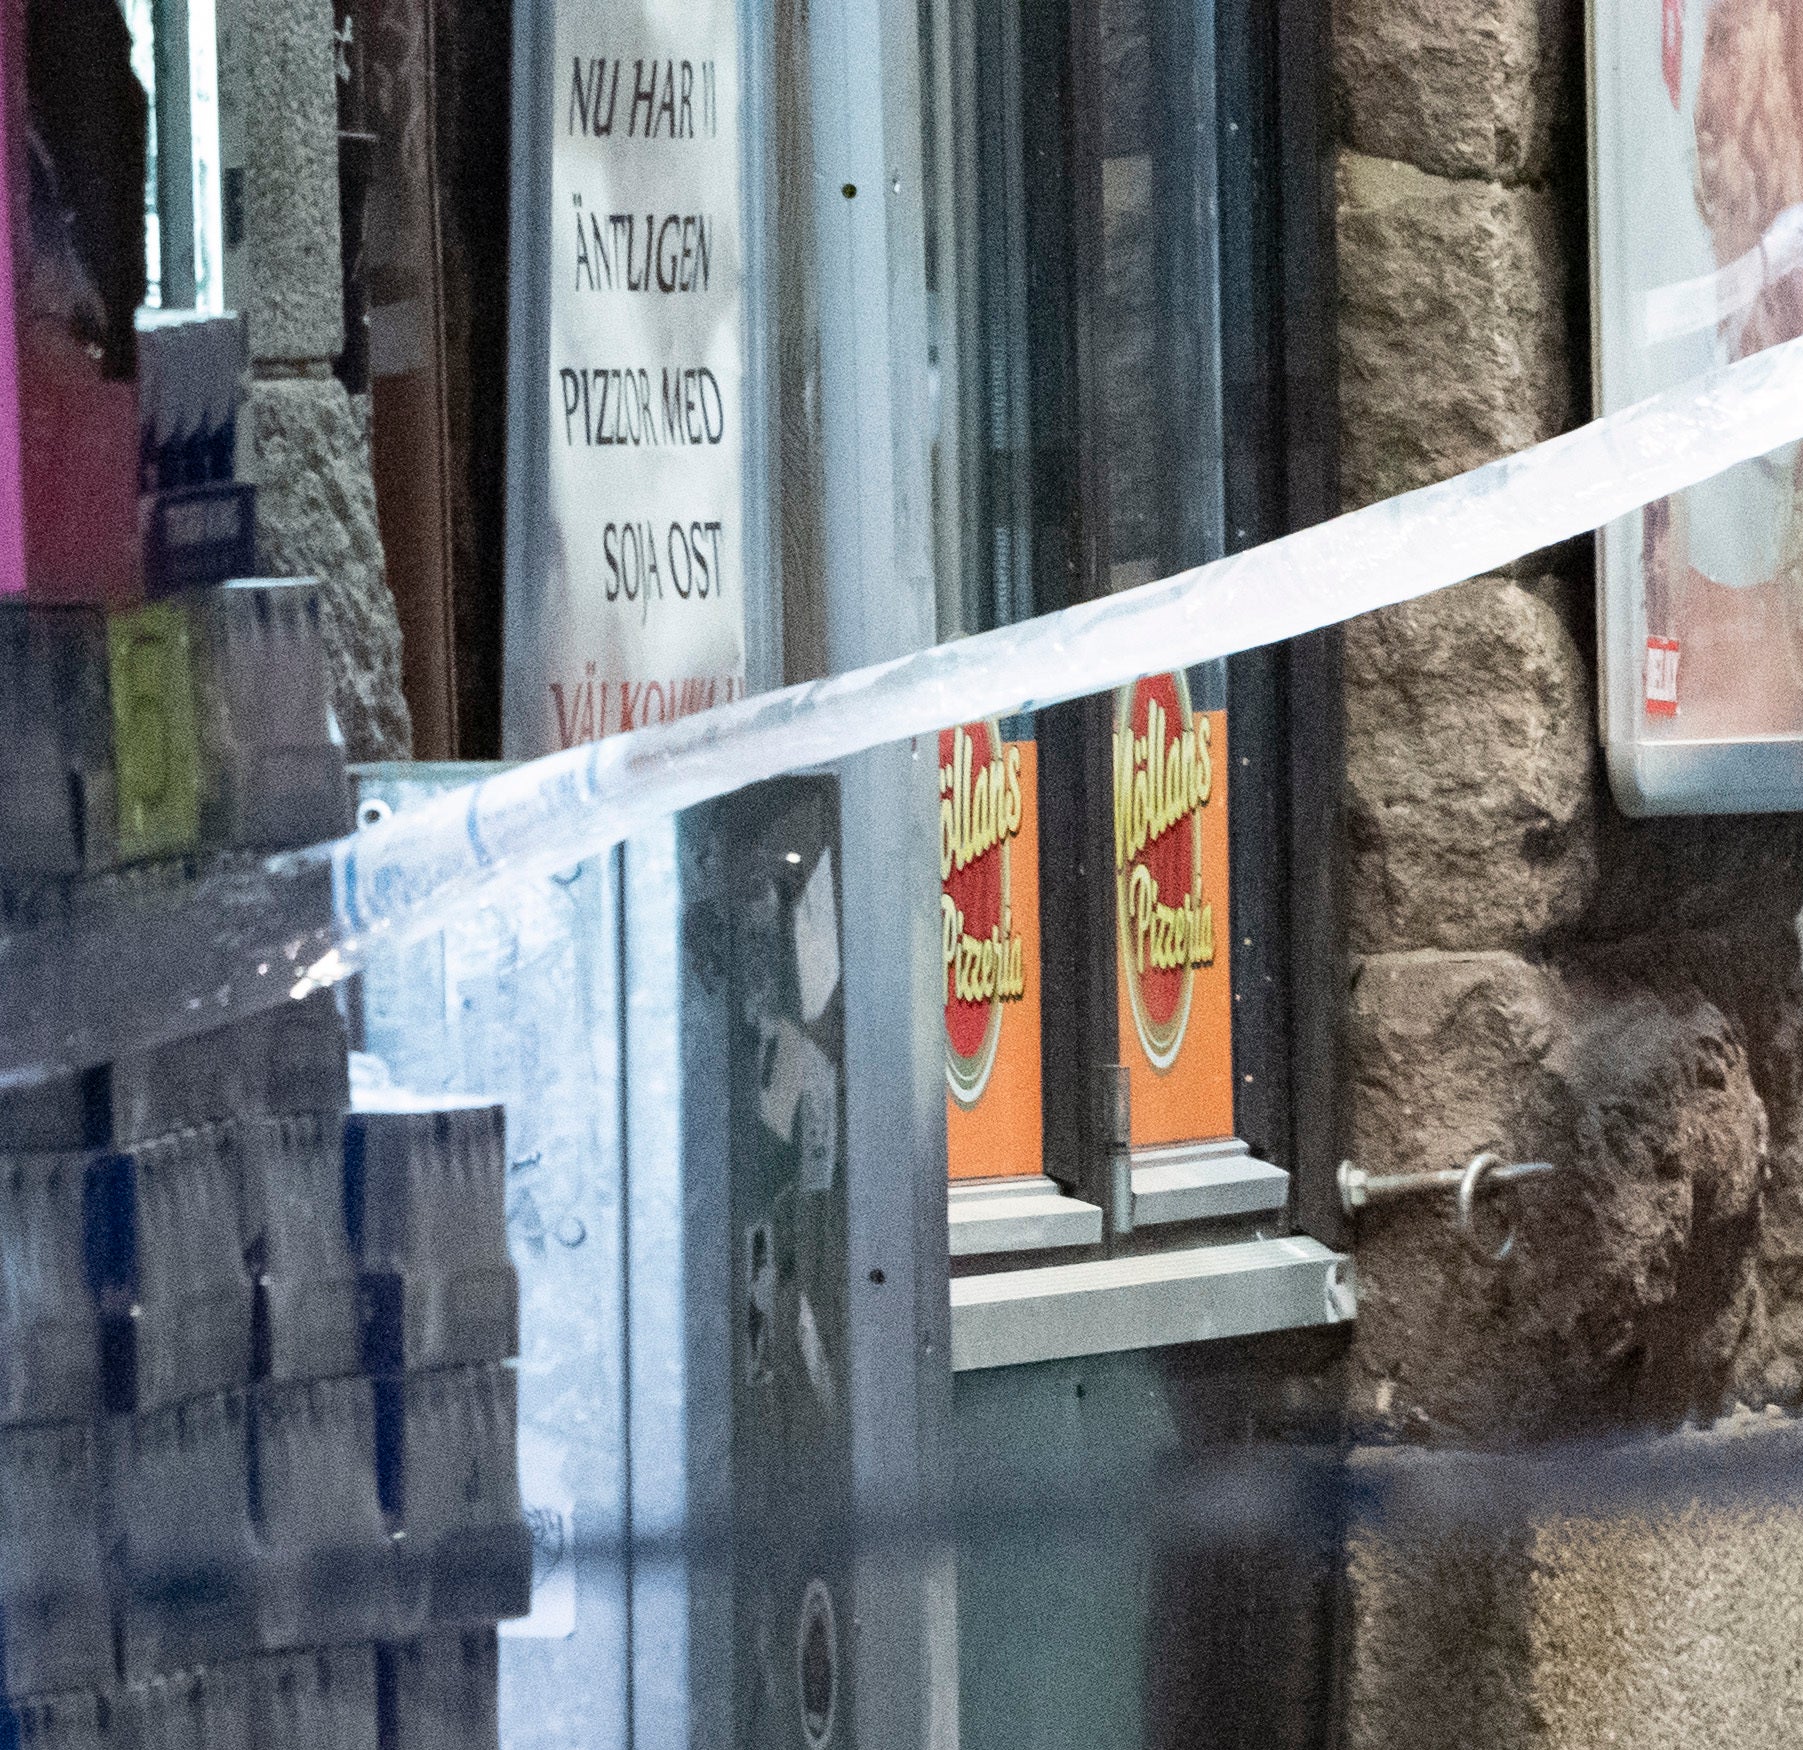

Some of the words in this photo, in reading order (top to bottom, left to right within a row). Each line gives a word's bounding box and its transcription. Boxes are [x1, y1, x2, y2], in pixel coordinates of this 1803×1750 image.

[568, 56, 620, 136] NU
[627, 58, 694, 139] HAR
[571, 192, 713, 293] ÄNTLIGEN
[559, 367, 659, 446] PIZZOR
[661, 366, 724, 446] MED
[603, 519, 663, 626] SOJA
[667, 520, 723, 601] OST
[940, 723, 1022, 881] öllans
[1129, 863, 1216, 974] Pizzeria
